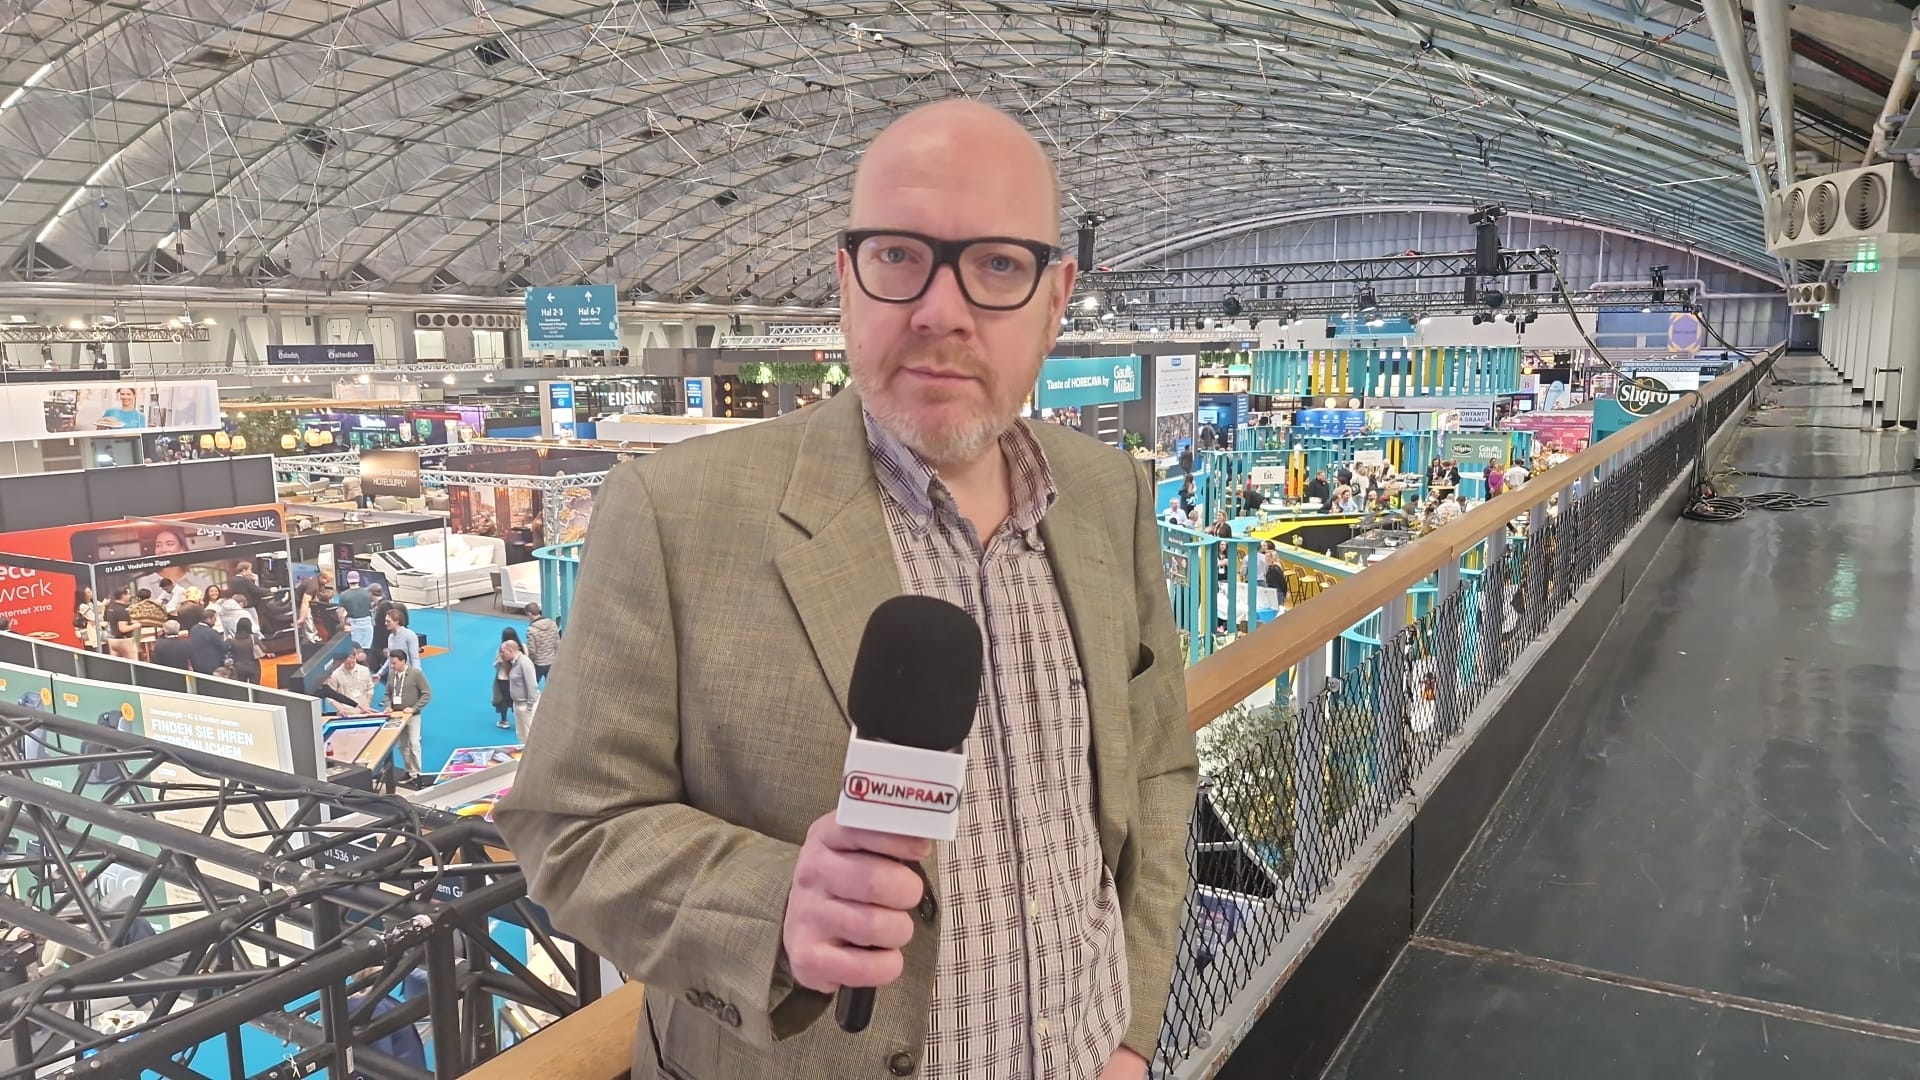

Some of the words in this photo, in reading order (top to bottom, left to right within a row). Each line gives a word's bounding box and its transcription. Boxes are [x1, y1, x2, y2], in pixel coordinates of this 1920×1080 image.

[541, 308, 552, 316] Hal
[553, 308, 564, 316] 2-3
[578, 307, 589, 316] Hal
[590, 307, 601, 315] 6-7
[1046, 379, 1064, 390] Taste
[1064, 378, 1071, 389] of
[1071, 376, 1102, 388] HORECAVA
[1102, 376, 1109, 387] by
[1113, 378, 1135, 394] Millau
[608, 390, 655, 406] EIJSINK
[1620, 384, 1668, 406] Sligro
[127, 561, 154, 570] Vodafone
[33, 604, 53, 613] Xtra
[152, 718, 193, 736] FINDEN
[195, 725, 215, 740] SIE
[217, 729, 254, 746] IHREN
[871, 781, 954, 806] WIJNPRAAT
